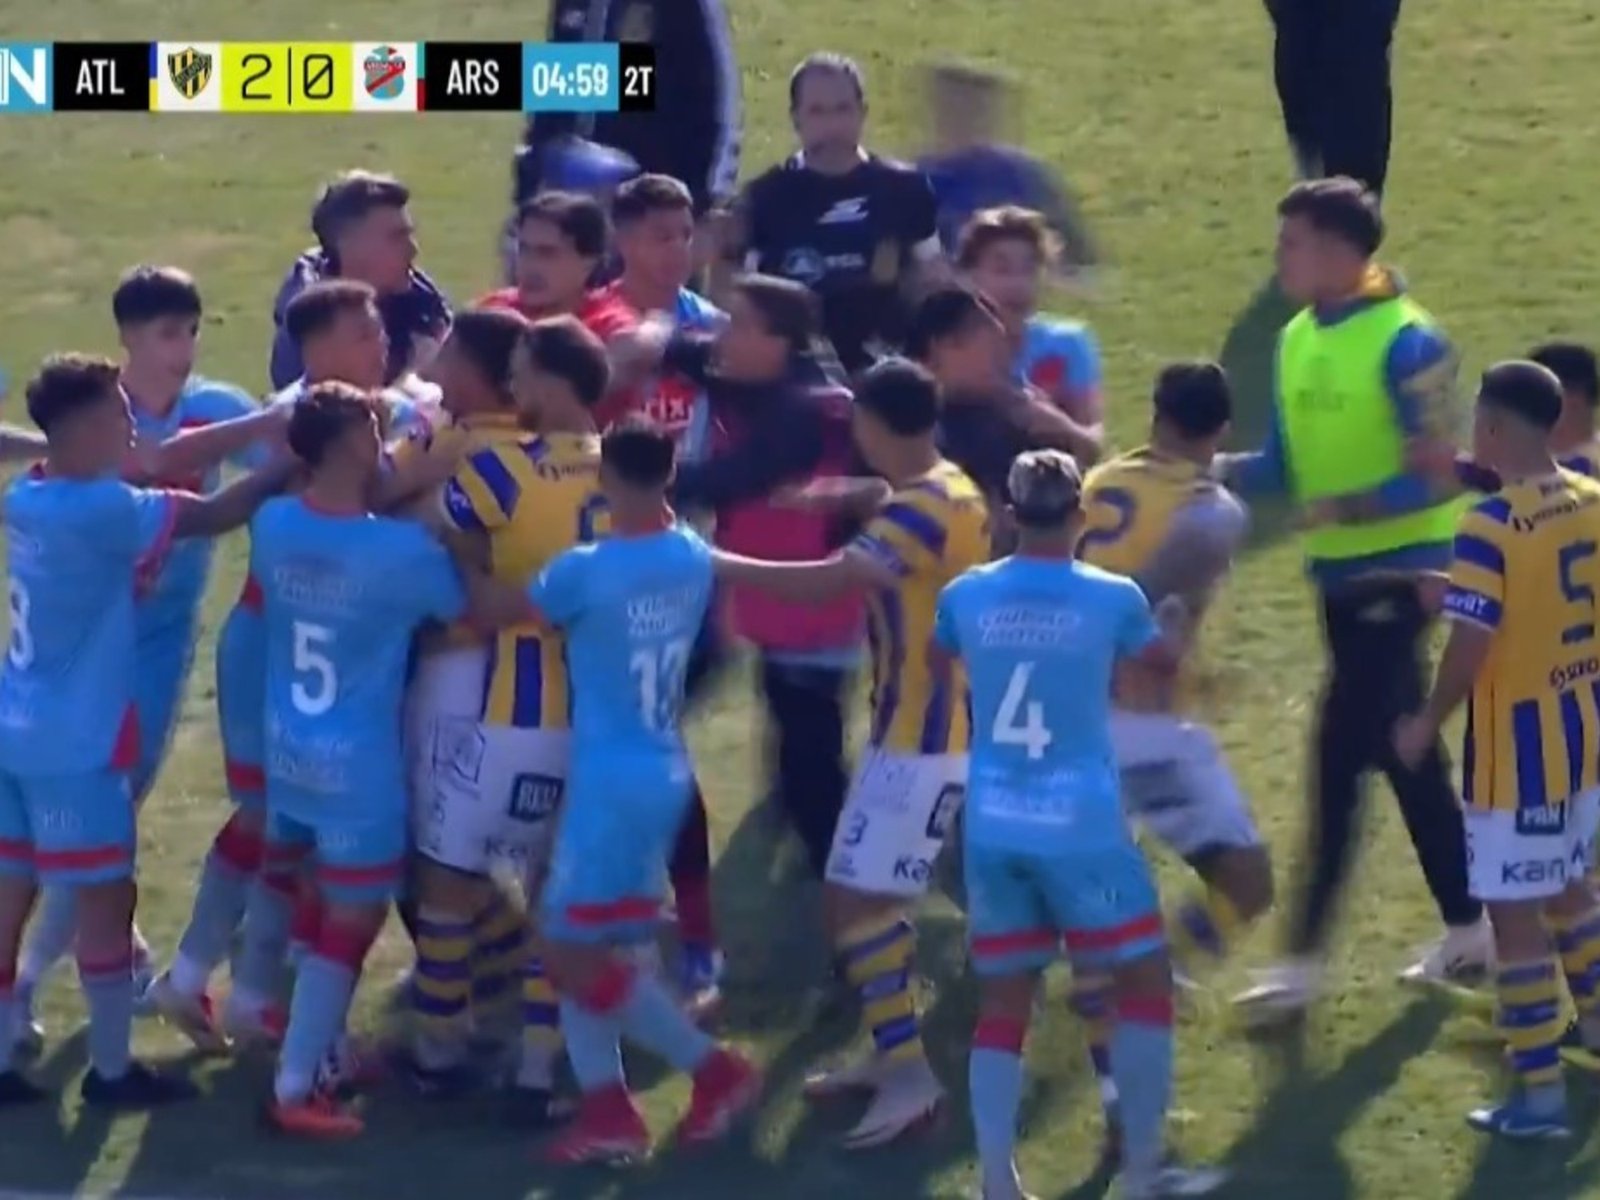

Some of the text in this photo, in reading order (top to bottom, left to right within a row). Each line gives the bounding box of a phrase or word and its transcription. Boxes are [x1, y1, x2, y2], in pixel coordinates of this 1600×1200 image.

[1558, 540, 1597, 645] 5
[291, 618, 338, 716] 5
[992, 661, 1052, 760] 4
[843, 810, 869, 847] 3
